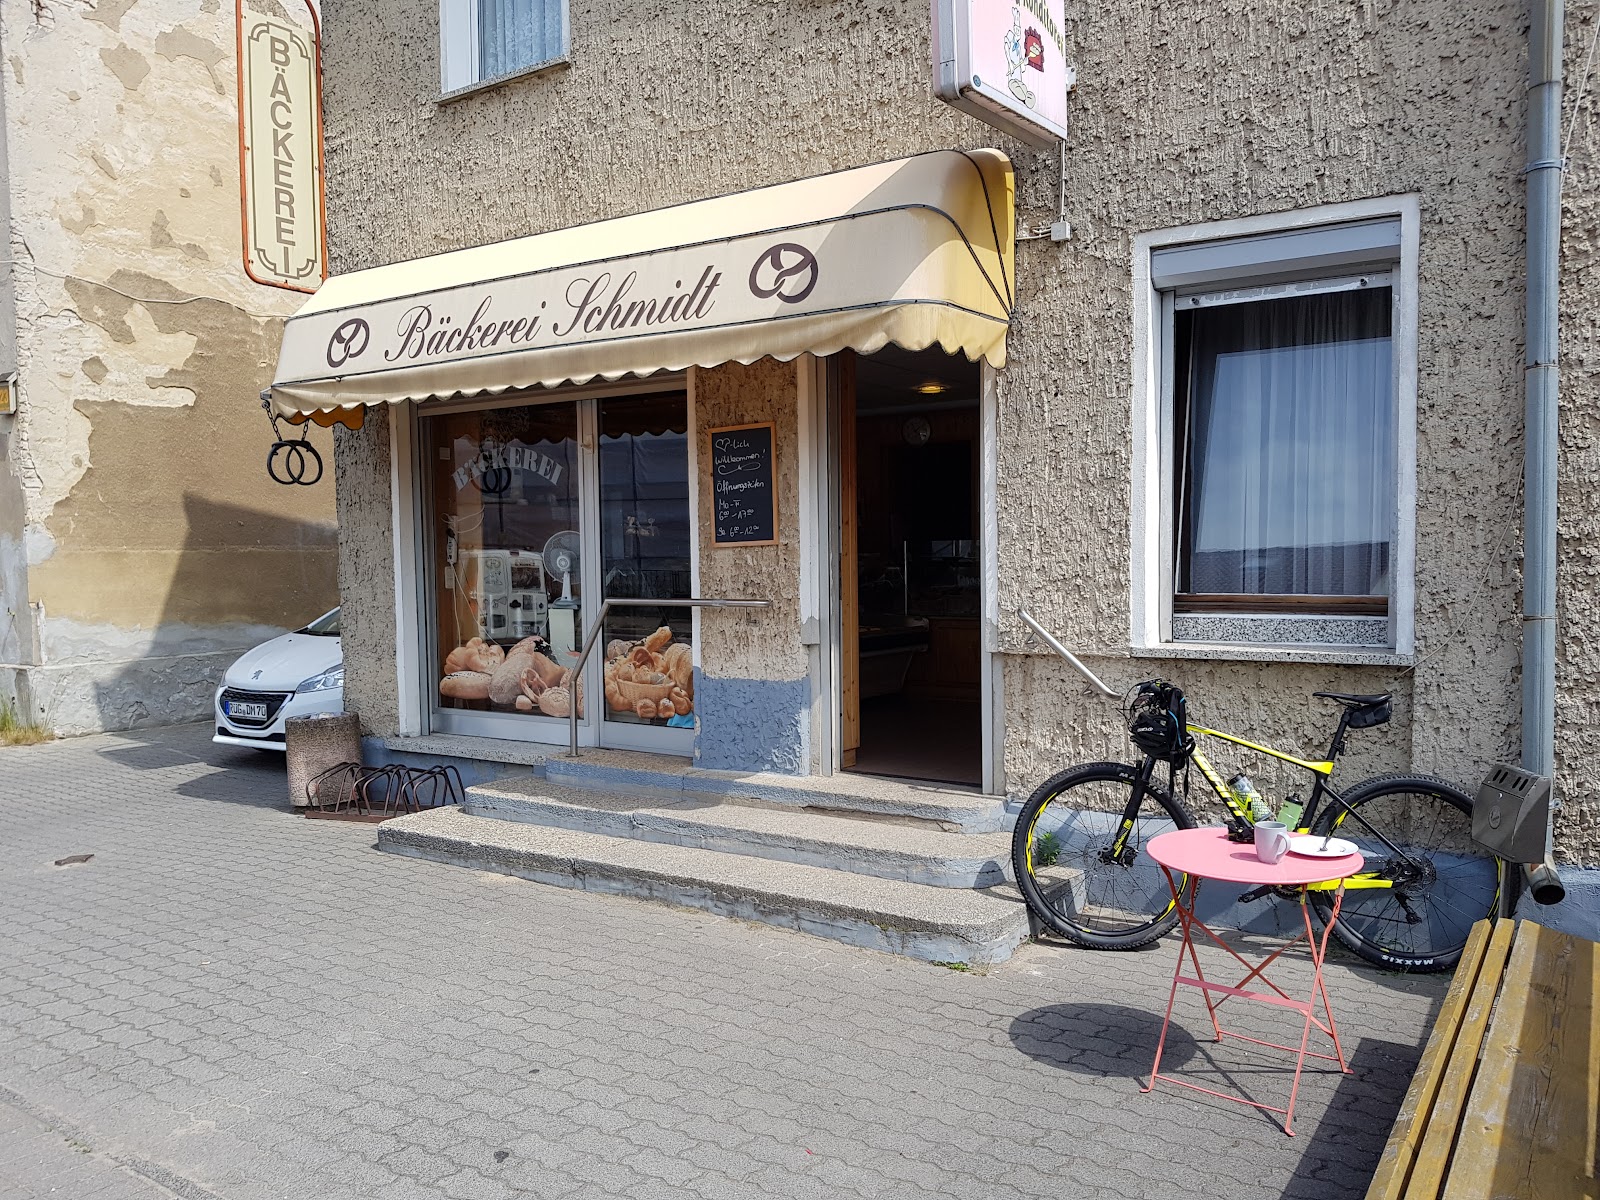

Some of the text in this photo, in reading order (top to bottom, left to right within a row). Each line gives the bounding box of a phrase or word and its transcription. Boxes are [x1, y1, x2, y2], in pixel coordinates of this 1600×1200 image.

[270, 36, 295, 273] BÄCKEREI
[383, 265, 726, 362] Bäckerei Schmidt
[246, 705, 256, 715] DM
[1381, 955, 1433, 965] MAXXIS
